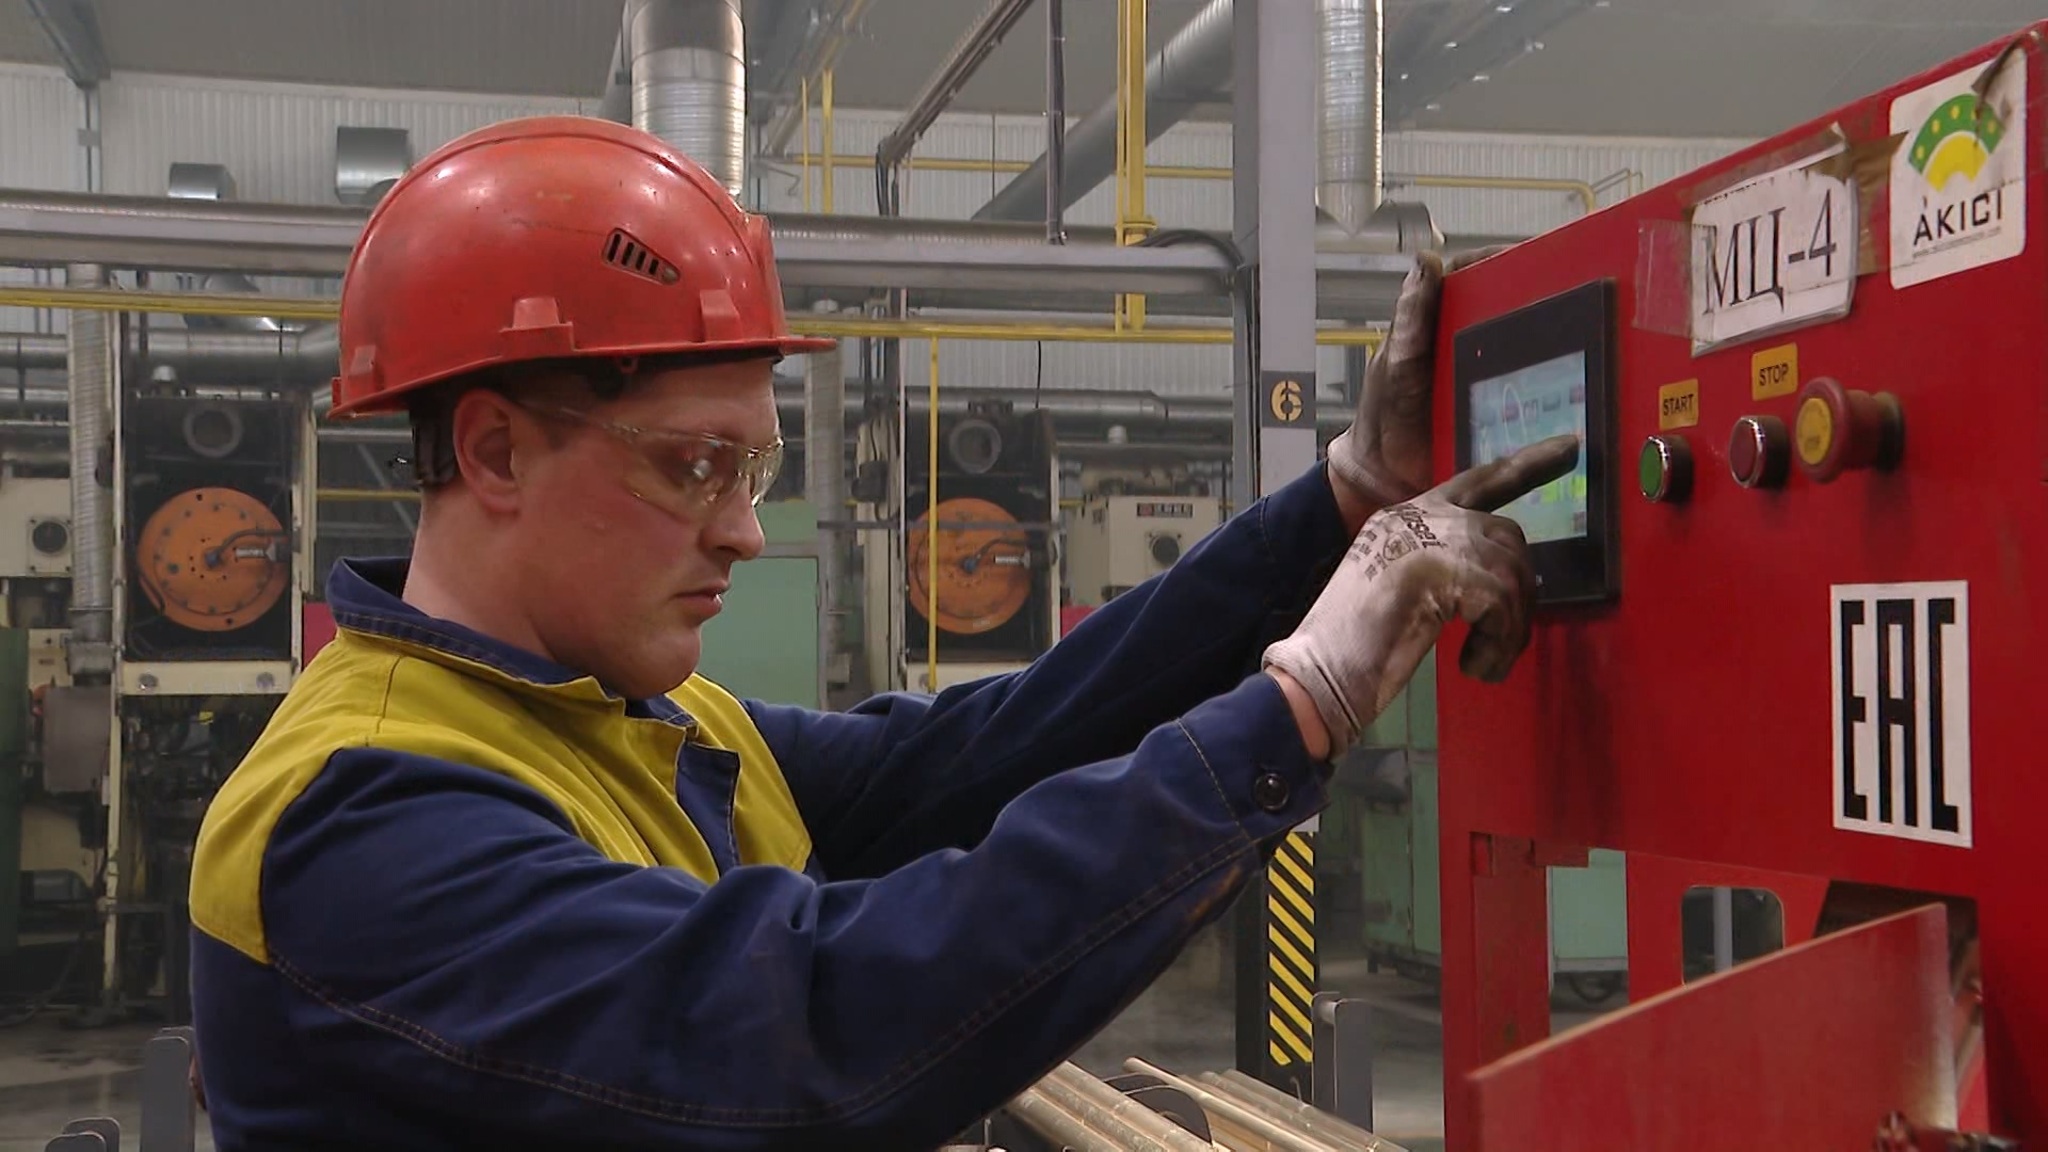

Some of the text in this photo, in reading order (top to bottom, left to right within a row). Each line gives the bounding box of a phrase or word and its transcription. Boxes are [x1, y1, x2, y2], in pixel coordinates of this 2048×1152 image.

[1692, 189, 1838, 315] МЦ-4
[1759, 363, 1790, 386] STOP
[1271, 380, 1302, 421] 6
[1663, 393, 1694, 416] START
[1840, 597, 1960, 834] EAC
